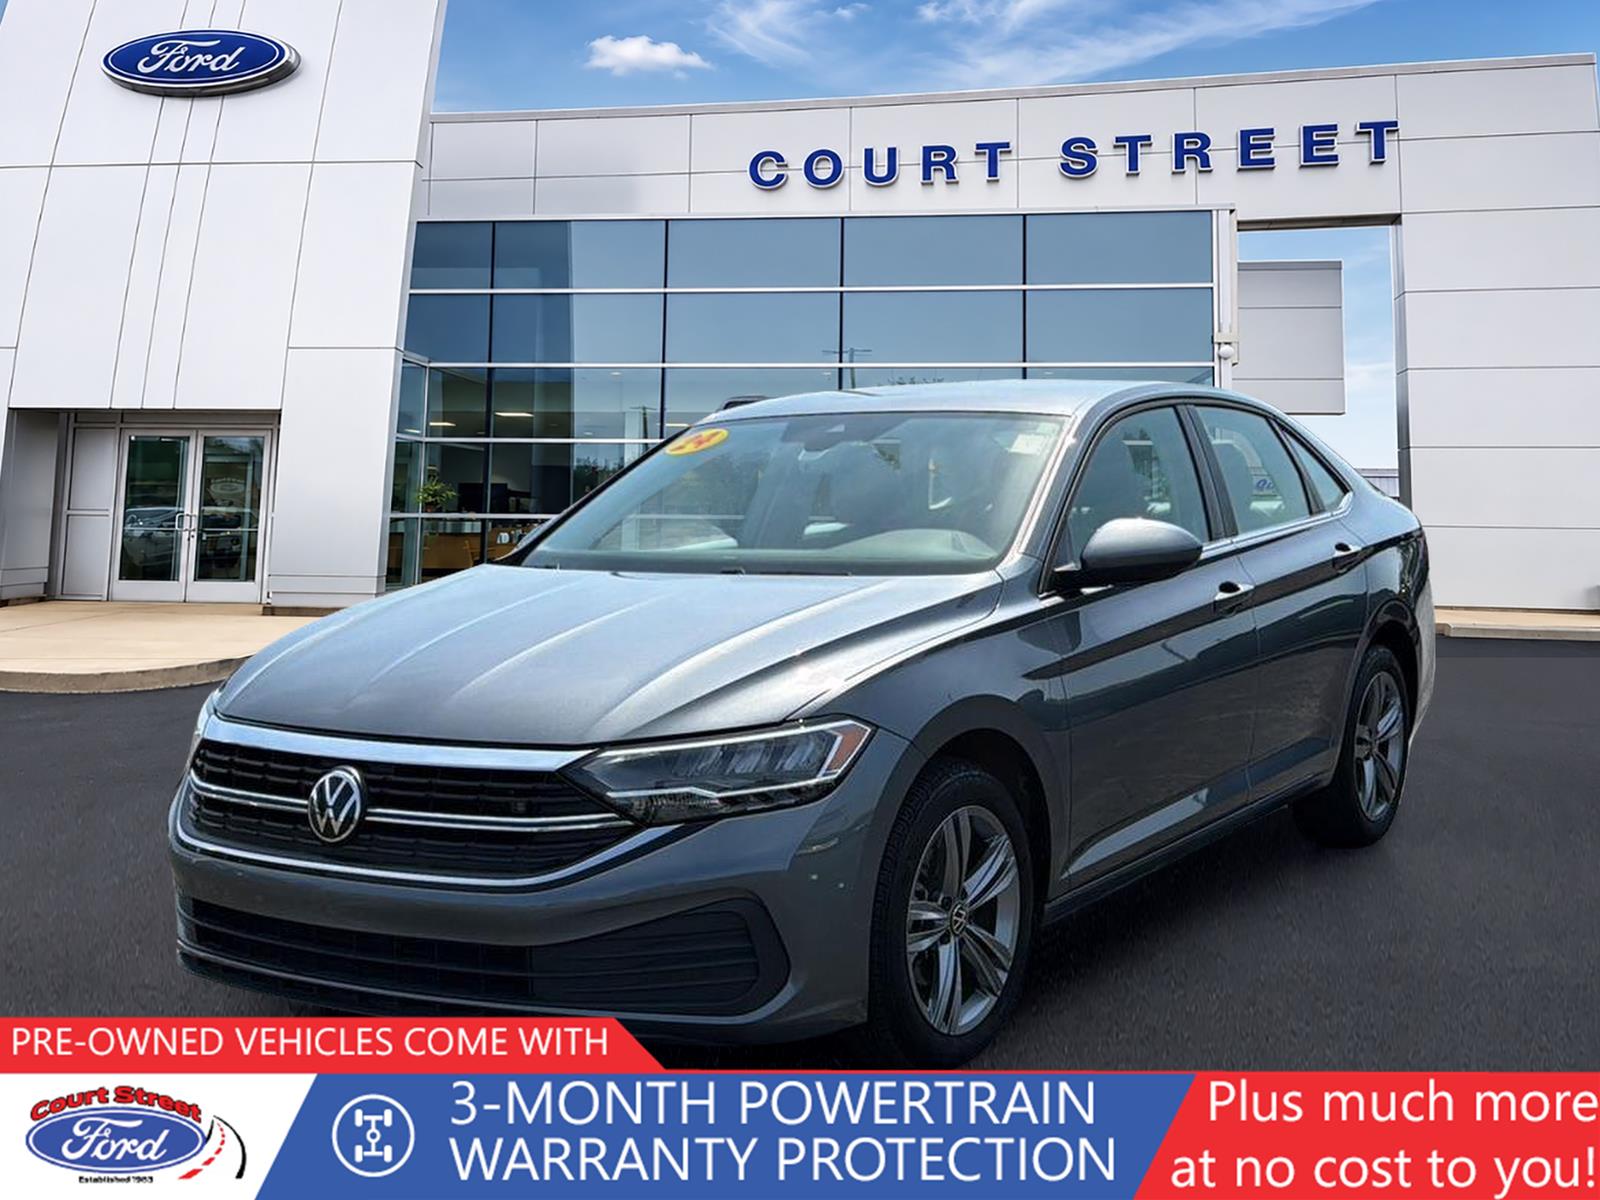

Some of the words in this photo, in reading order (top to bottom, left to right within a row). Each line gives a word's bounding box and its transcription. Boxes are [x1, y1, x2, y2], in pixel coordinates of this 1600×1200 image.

[137, 38, 245, 75] Ford
[749, 142, 1010, 188] COURT
[1060, 120, 1398, 179] STREET
